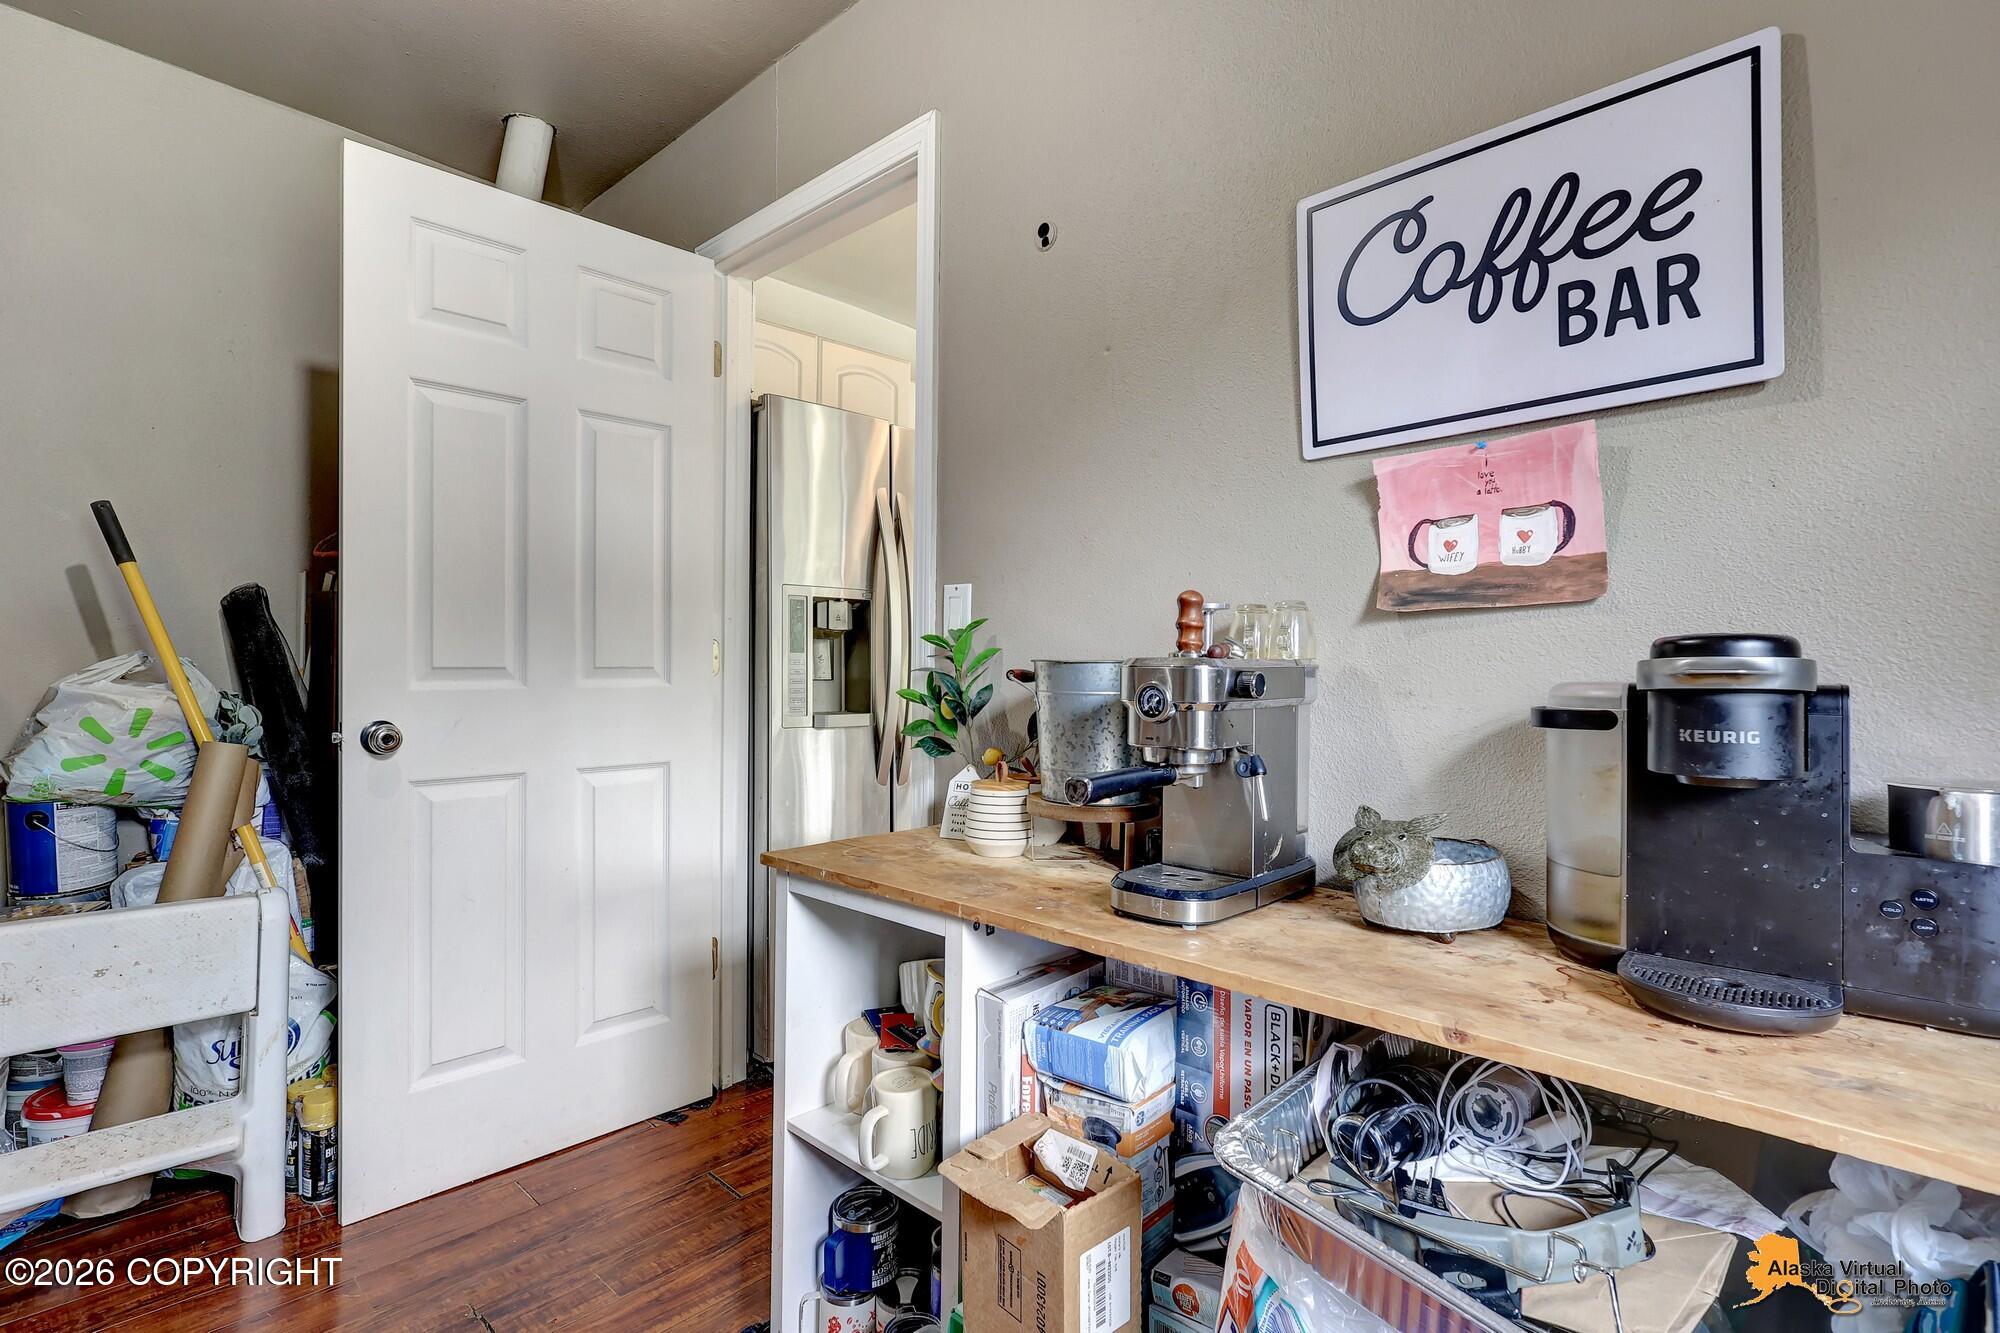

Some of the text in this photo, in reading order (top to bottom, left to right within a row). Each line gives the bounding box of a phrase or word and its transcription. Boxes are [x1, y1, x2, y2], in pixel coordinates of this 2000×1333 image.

[1337, 168, 1703, 326] Coffee
[1558, 252, 1701, 347] BAR
[1477, 470, 1495, 480] love
[1484, 477, 1496, 488] you
[1438, 551, 1465, 562] WIFEY
[1679, 728, 1761, 744] KEURIG
[955, 783, 970, 791] HO
[1244, 998, 1253, 1038] VAPOR
[1110, 1015, 1144, 1043] TRAINING
[1244, 1039, 1253, 1058] EN
[1244, 1060, 1253, 1079] UN
[910, 1120, 937, 1160] RIDE
[1194, 1131, 1204, 1141] 2
